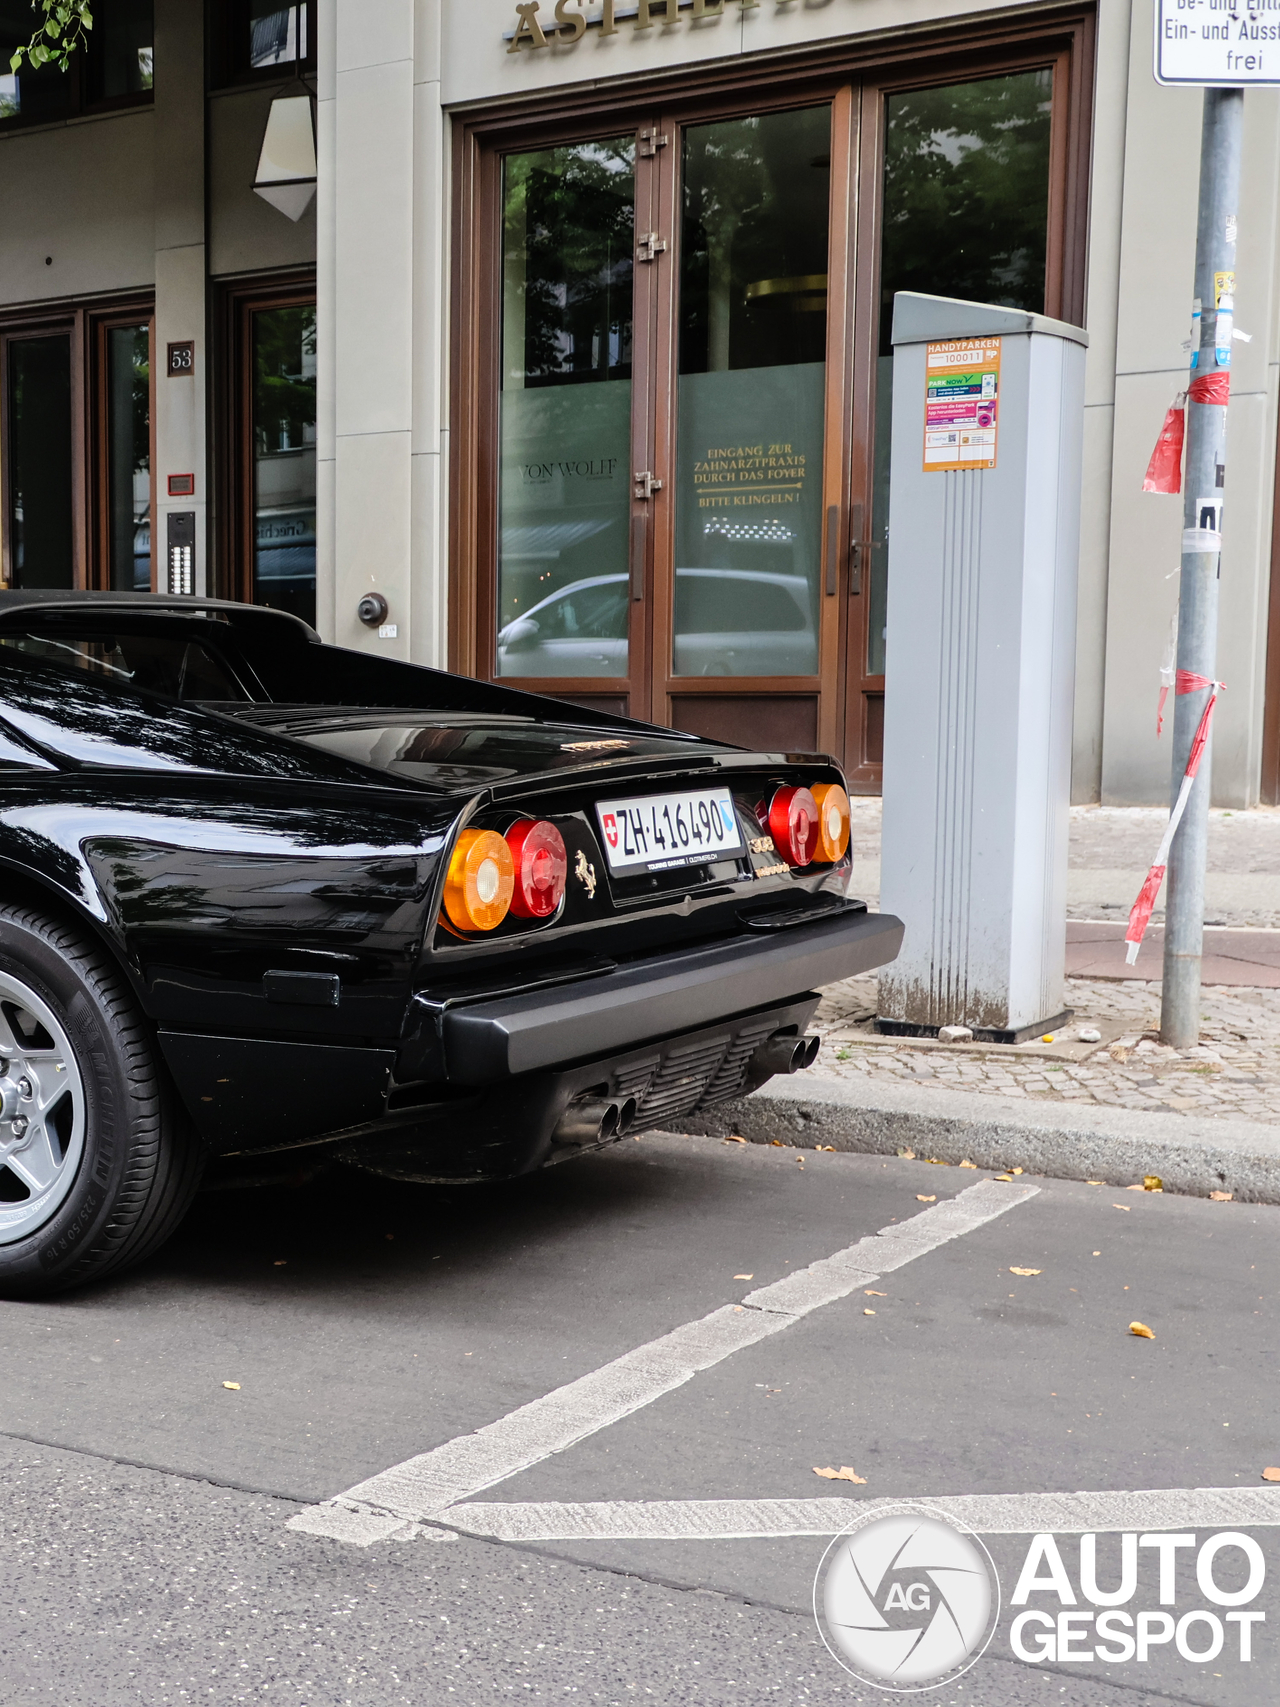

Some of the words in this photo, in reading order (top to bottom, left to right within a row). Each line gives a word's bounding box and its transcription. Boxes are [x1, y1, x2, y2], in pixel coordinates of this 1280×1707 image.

[1165, 19, 1196, 40] Ein-
[1202, 20, 1229, 41] und
[1227, 50, 1263, 71] frei
[928, 339, 1000, 353] HANDYPARKEN
[171, 349, 192, 369] 53
[945, 352, 980, 363] 100011
[708, 445, 763, 459] EINGANG
[768, 444, 792, 455] ZUR
[694, 454, 806, 472] ZAHNARZTPRAXIS
[694, 472, 735, 484] DURCH
[740, 470, 764, 481] DAS
[767, 467, 806, 479] FOYER
[698, 496, 731, 508] BITTE
